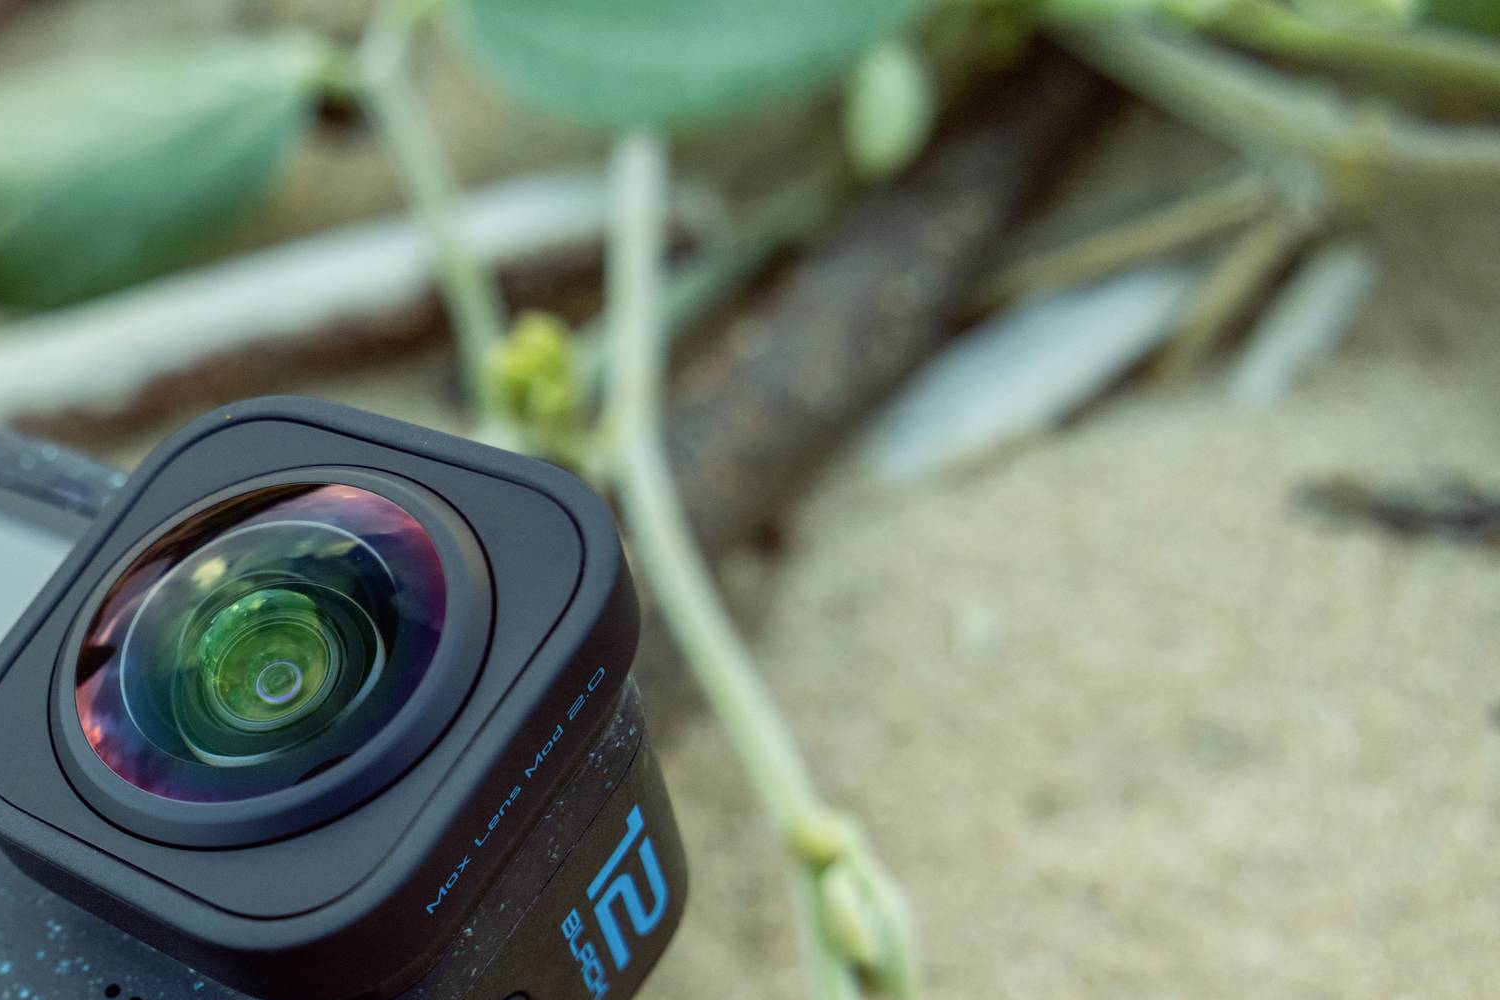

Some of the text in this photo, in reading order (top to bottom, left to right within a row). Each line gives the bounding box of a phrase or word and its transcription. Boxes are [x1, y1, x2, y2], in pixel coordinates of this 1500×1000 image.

[426, 666, 606, 915] Max Lens Mod 2.0
[586, 803, 671, 971] 12
